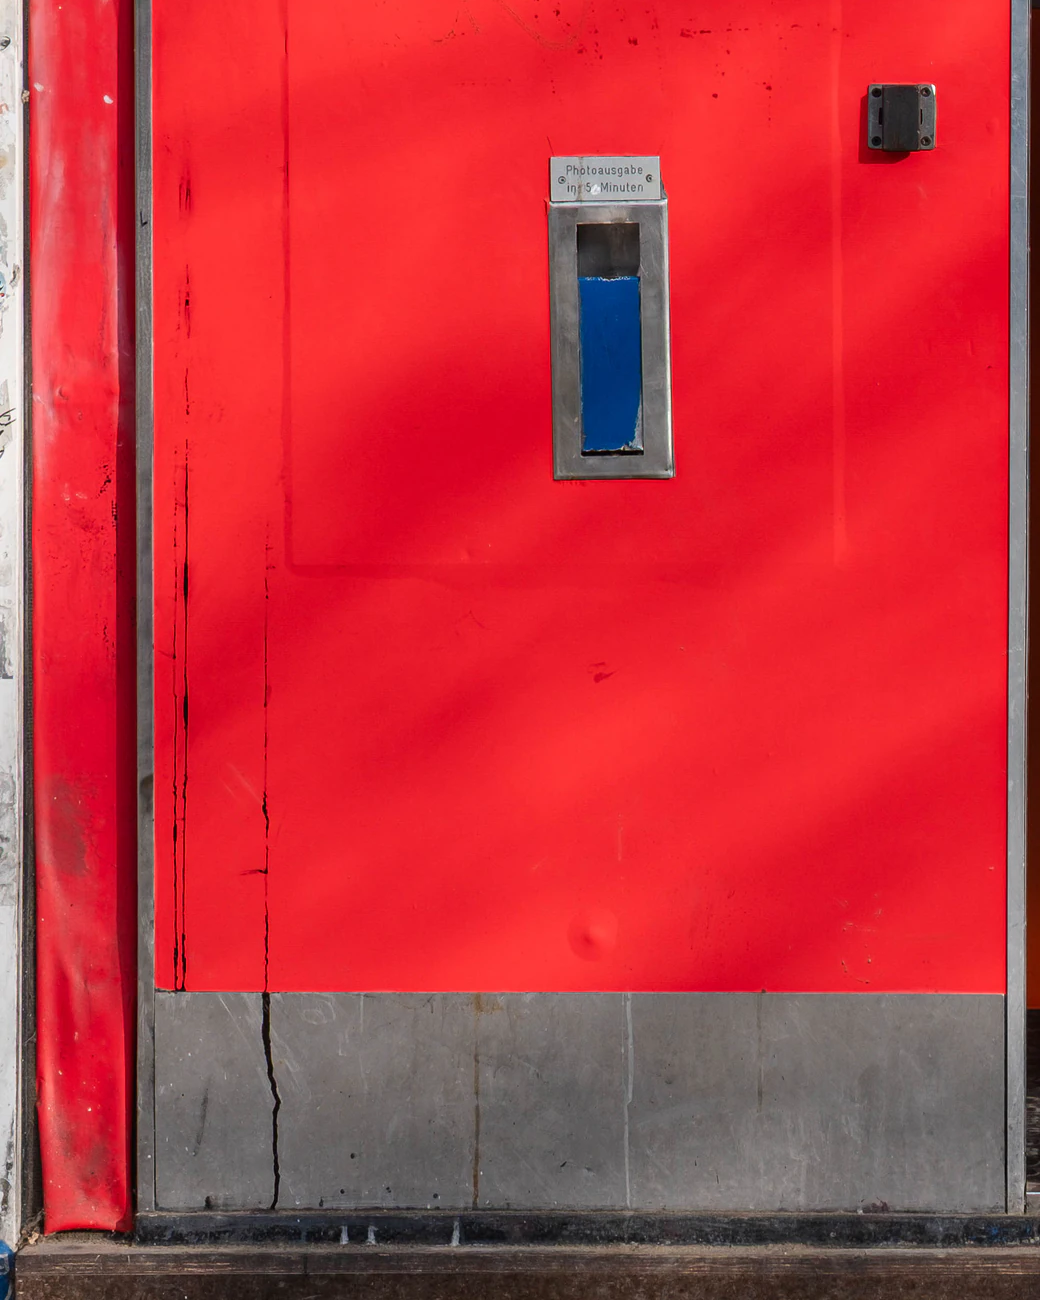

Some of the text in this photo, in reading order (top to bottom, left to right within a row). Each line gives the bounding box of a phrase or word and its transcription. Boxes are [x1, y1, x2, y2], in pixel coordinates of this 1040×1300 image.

[566, 165, 643, 177] Photoausgabe
[567, 183, 576, 195] in
[600, 182, 644, 193] Minuten
